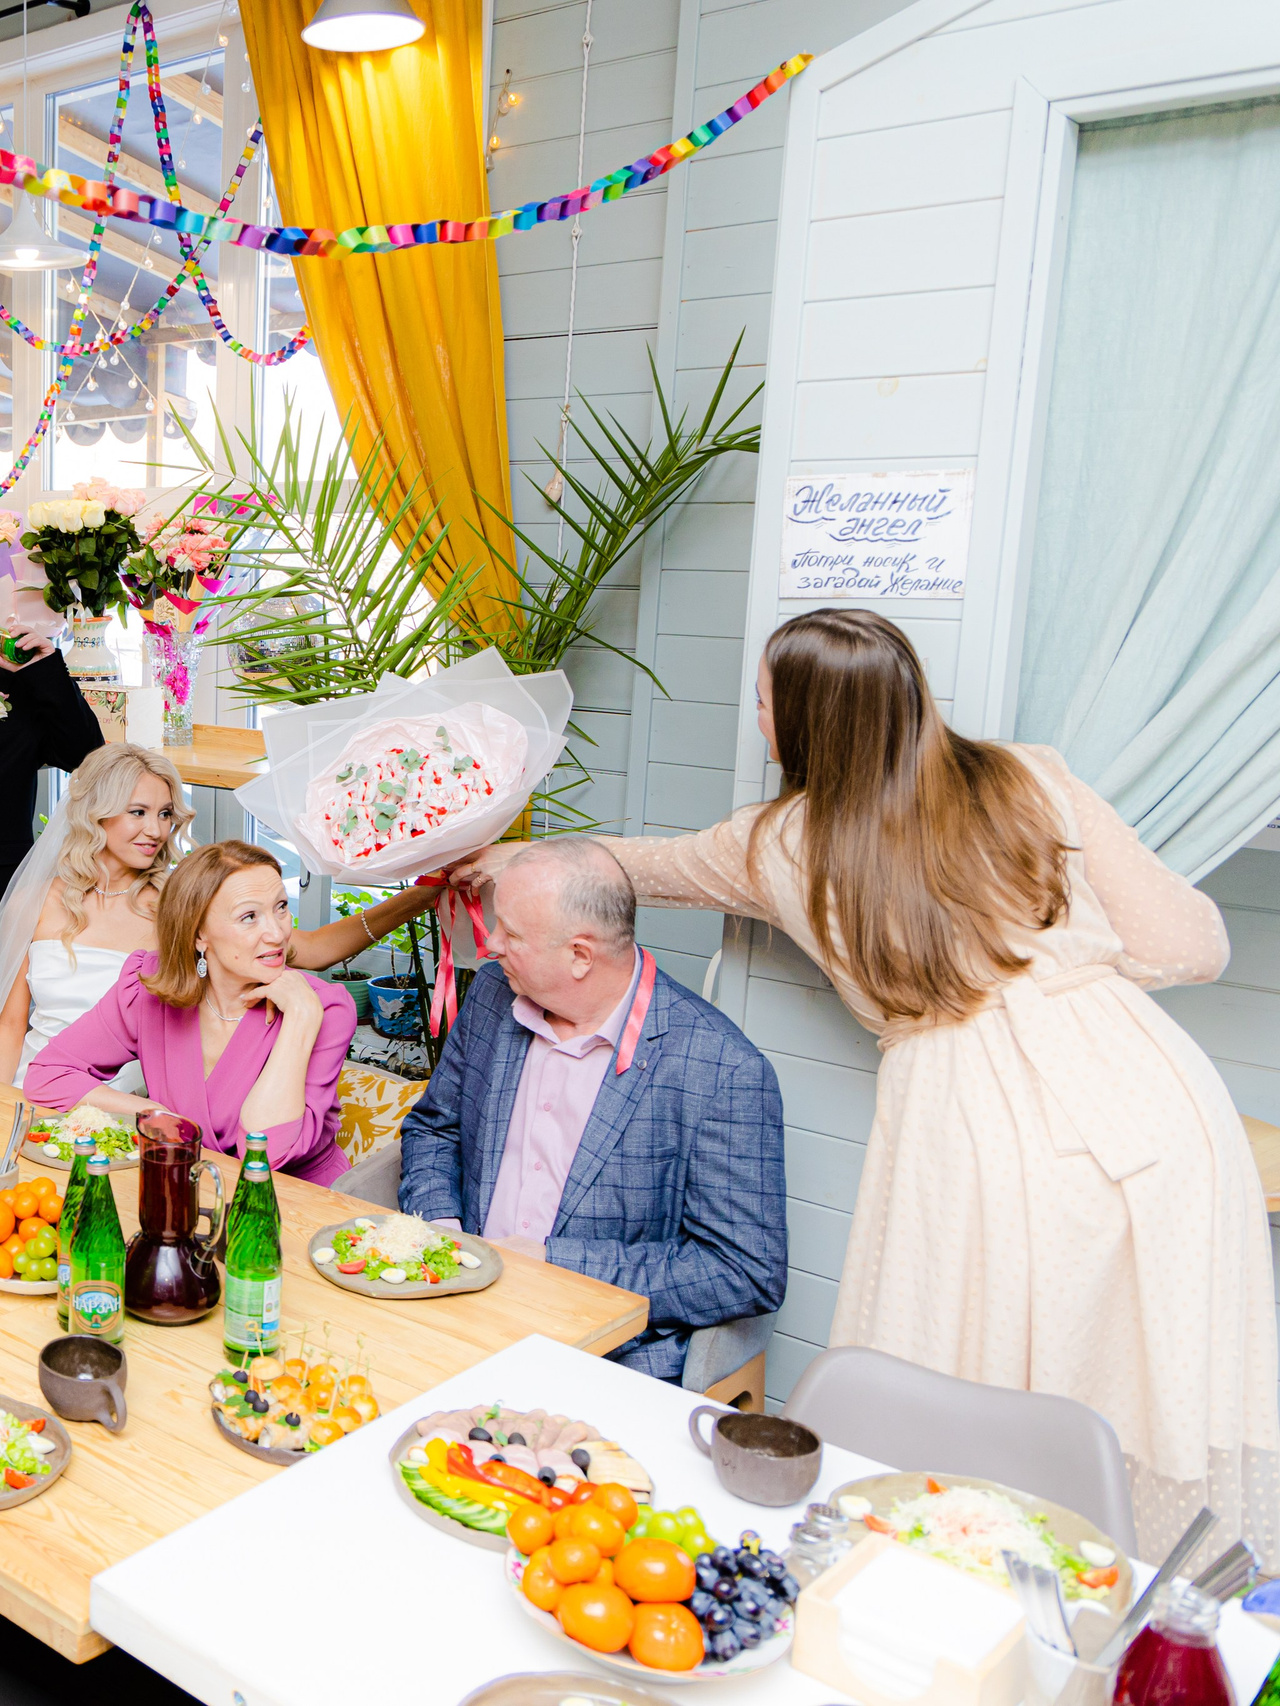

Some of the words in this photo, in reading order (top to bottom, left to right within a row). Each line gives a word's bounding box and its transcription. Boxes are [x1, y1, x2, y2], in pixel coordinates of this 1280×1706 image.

[792, 483, 953, 515] Желанный
[838, 517, 924, 537] ангел
[791, 548, 854, 572] Потри
[863, 552, 919, 573] носик
[925, 556, 946, 572] и
[797, 567, 882, 589] загадай
[72, 1294, 122, 1314] НАРЗАН
